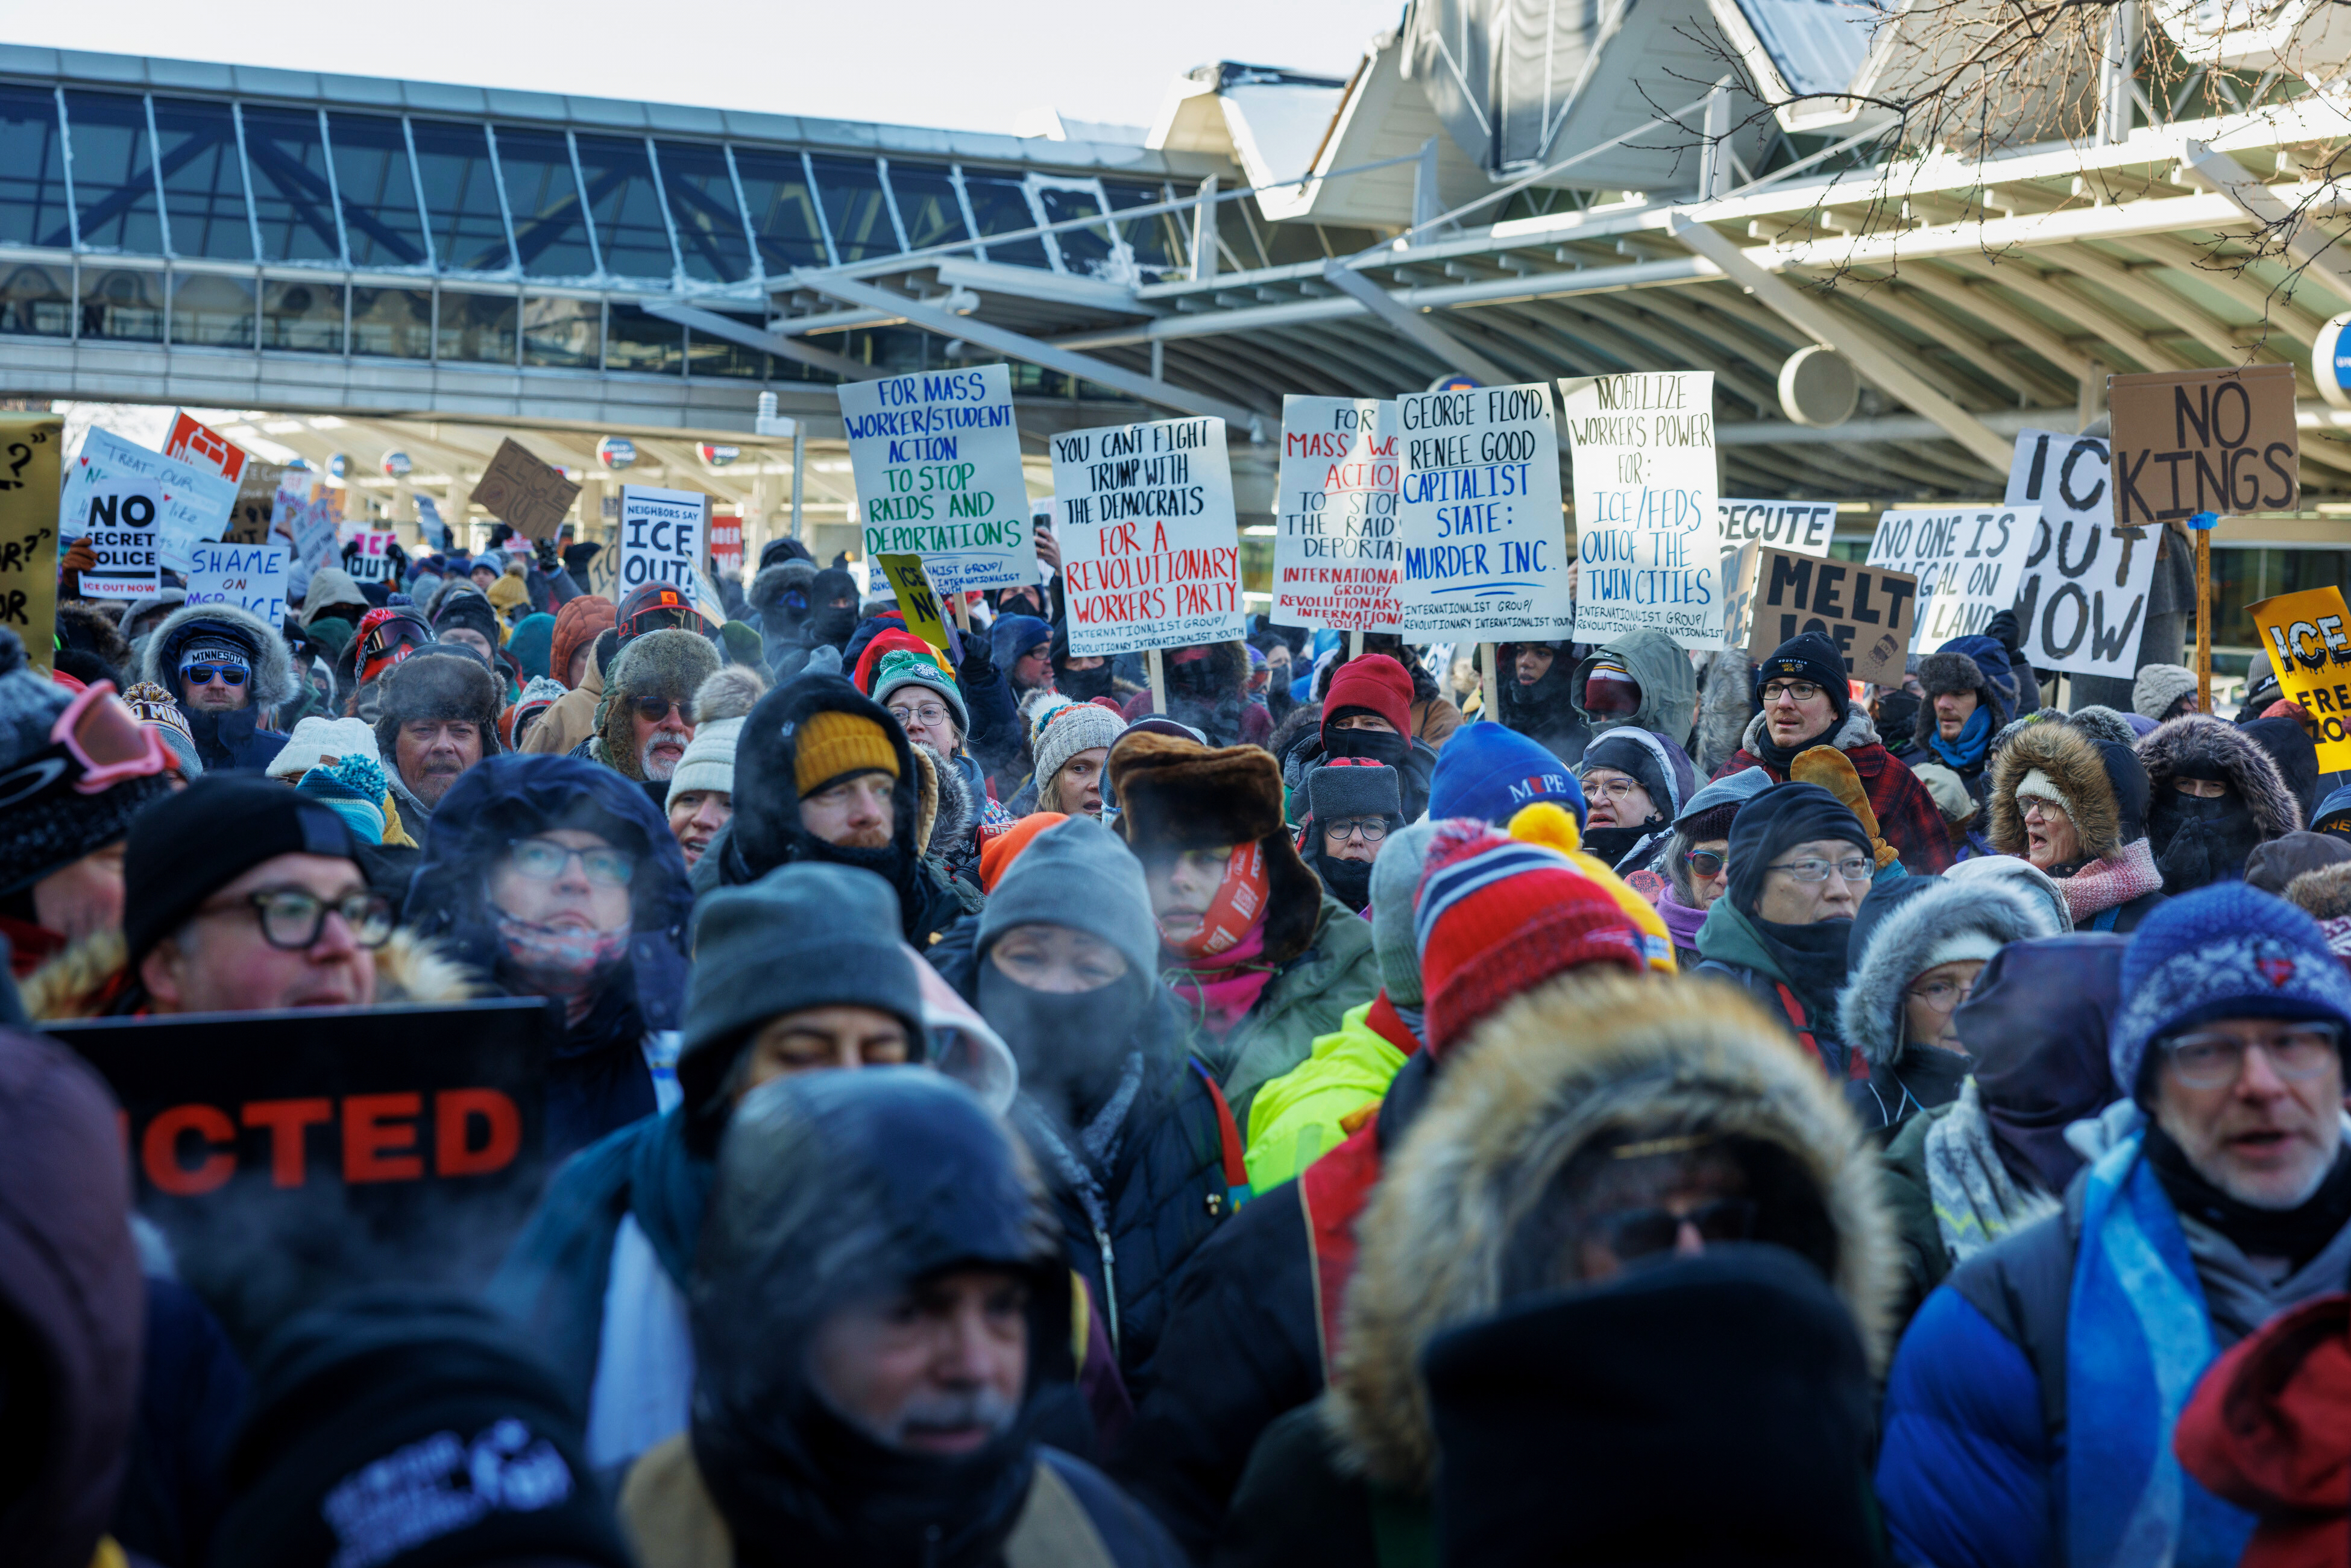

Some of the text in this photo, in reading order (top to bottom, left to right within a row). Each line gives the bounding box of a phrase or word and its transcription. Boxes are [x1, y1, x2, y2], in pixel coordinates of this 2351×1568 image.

[878, 372, 986, 406] FOR MASS
[1594, 374, 1688, 411] MOBILIZE
[845, 404, 1012, 440] WORKER/STUDENT
[1334, 409, 1376, 432] FOR
[1403, 389, 1550, 430] GEORGE FLOYD,
[2174, 381, 2251, 450] NO
[1056, 420, 1212, 464] YOU CAN'T FIGHT
[1287, 432, 1350, 458] MASS
[1571, 413, 1712, 448] WORKERS POWER
[889, 435, 957, 464] ACTION
[1410, 430, 1536, 470] RENEE GOOD
[103, 442, 194, 494] TREAT OUR
[882, 462, 975, 493] TO STOP
[1086, 453, 1188, 493] TRUMP WITH
[1324, 464, 1399, 490] ACTIO
[1403, 463, 1532, 504] CAPITALIST
[1619, 452, 1652, 485] FOR:
[2118, 442, 2294, 524] KINGS
[89, 494, 156, 528] NO
[628, 505, 699, 521] NEIGHBORS SAY
[869, 491, 994, 523] RAIDS AND
[1063, 496, 1094, 524] THE
[1100, 486, 1204, 521] DEMOCRATS
[1299, 491, 1326, 512] TO
[1285, 513, 1402, 538] THE RAID
[1437, 502, 1513, 538] STATE:
[1874, 513, 2016, 559] NO ONE IS
[626, 519, 693, 556] ICE
[866, 519, 1022, 555] DEPORTATIONS
[1100, 520, 1168, 557] FOR A
[1649, 531, 1692, 568] THE
[96, 551, 156, 565] OLICE
[192, 549, 282, 575] SHAME
[965, 561, 1003, 575] GROUP/
[1066, 547, 1239, 595] REVOLUTIONARY
[1406, 540, 1557, 581] MURDER INC.
[84, 582, 156, 593] ICE OUT NOW
[222, 578, 247, 590] ON
[895, 567, 927, 587] ICE
[936, 586, 961, 595] OUTH
[937, 573, 1020, 587] INTERNATIONALIST
[1333, 584, 1392, 598] GROUP/
[1586, 568, 1711, 605] TWIN CITIES
[1767, 555, 1917, 629] MELT
[1968, 562, 2002, 596] ON
[1074, 581, 1236, 625] WORKERS PARTY
[1280, 594, 1403, 612] REVOLUTIONARY
[1404, 598, 1533, 616] INTERNATIONALIST GROUP/
[1578, 605, 1707, 628] INTERNATIONALIST GROUP/
[1071, 615, 1227, 640] INTERNATIONALIST GROUP/
[1326, 619, 1373, 631] YOUTH
[1404, 618, 1471, 631] REVOLUTIONARY
[1474, 616, 1549, 629] INTERNATIONALIST
[1577, 619, 1640, 632] REVOLUTIONAR
[1931, 602, 1997, 639] LAND
[1071, 628, 1245, 653] REVOLUTIONARY INTERNATIONALIST YOUTH
[2269, 614, 2351, 676] ICE
[192, 650, 244, 666] MINNESOTA
[2296, 684, 2351, 716] FRE
